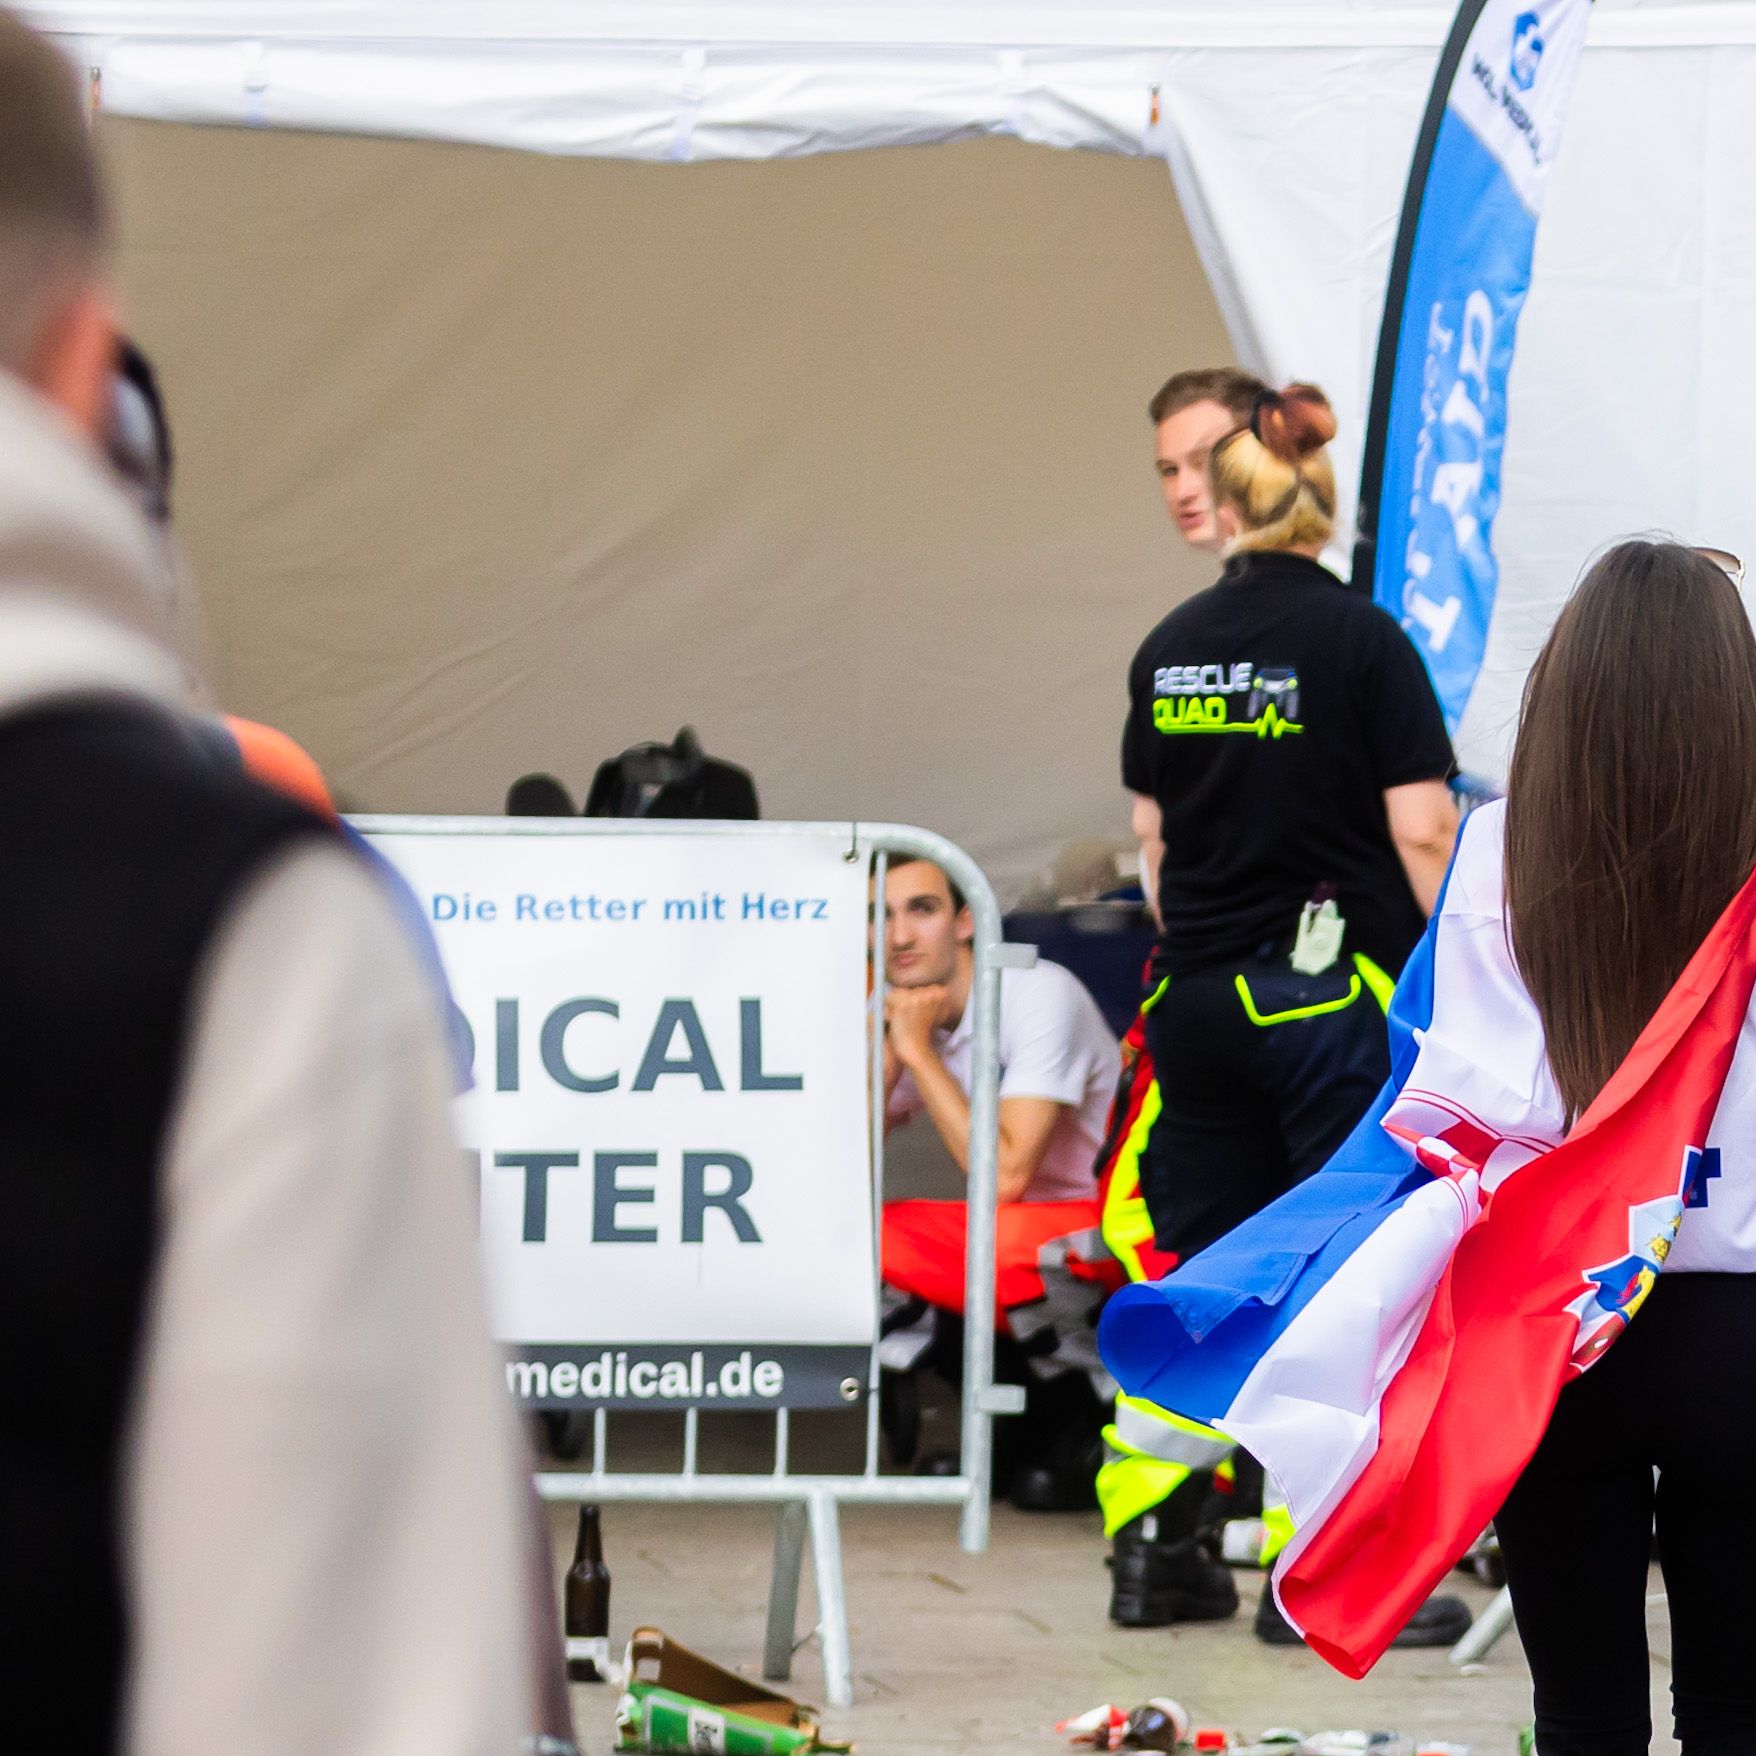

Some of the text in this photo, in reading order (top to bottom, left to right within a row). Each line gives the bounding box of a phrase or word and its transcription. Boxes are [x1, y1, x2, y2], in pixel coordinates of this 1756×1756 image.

[1154, 661, 1254, 695] RESCUE
[431, 891, 829, 921] Die Retter mit Herz
[486, 995, 805, 1094] ICAL
